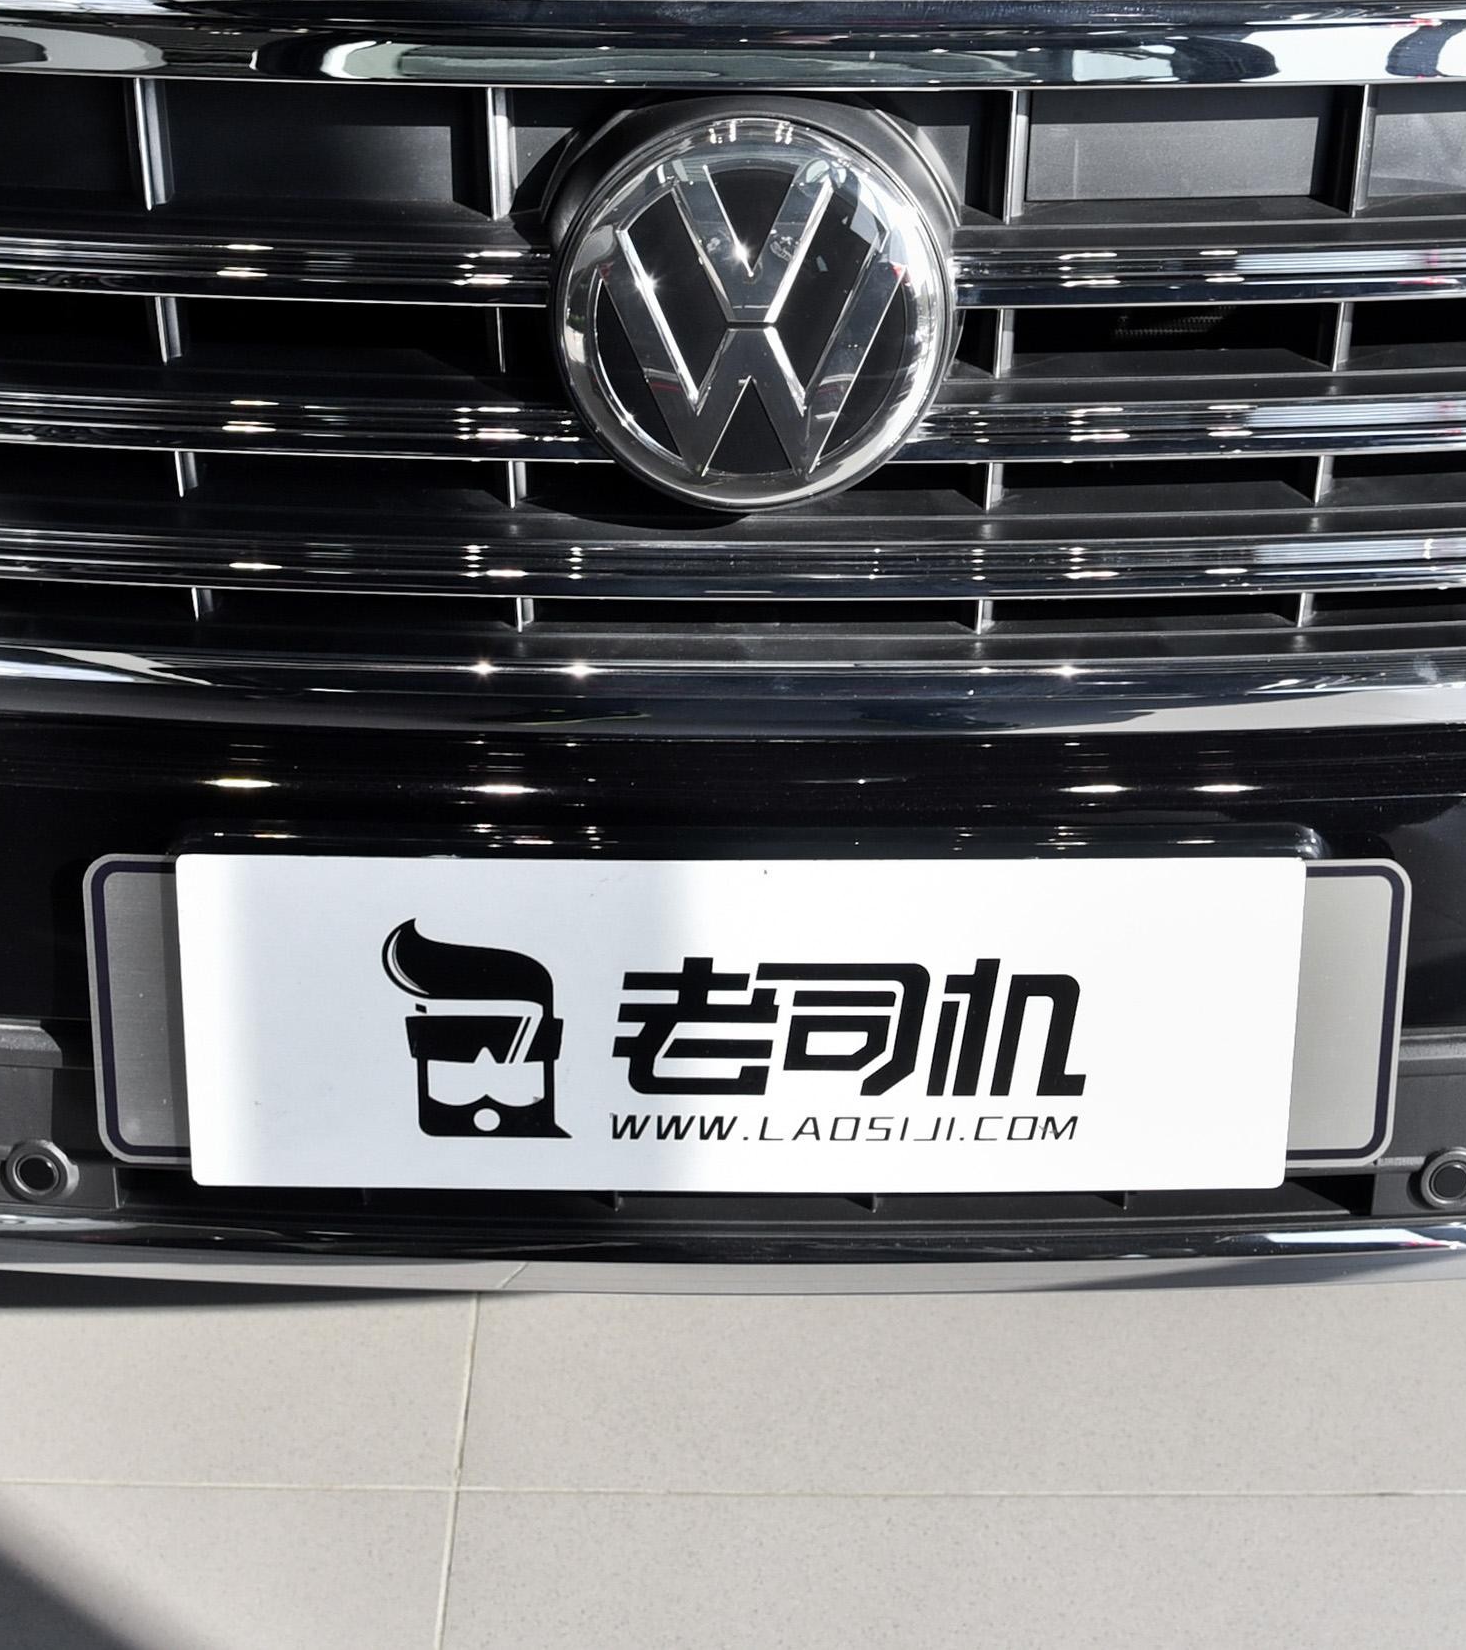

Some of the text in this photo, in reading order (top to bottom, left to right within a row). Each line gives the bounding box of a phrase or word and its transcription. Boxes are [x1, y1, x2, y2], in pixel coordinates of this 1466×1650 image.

[612, 957, 1086, 1096] 老司机
[610, 1113, 1078, 1141] WWW.LAOSIJI.COM
